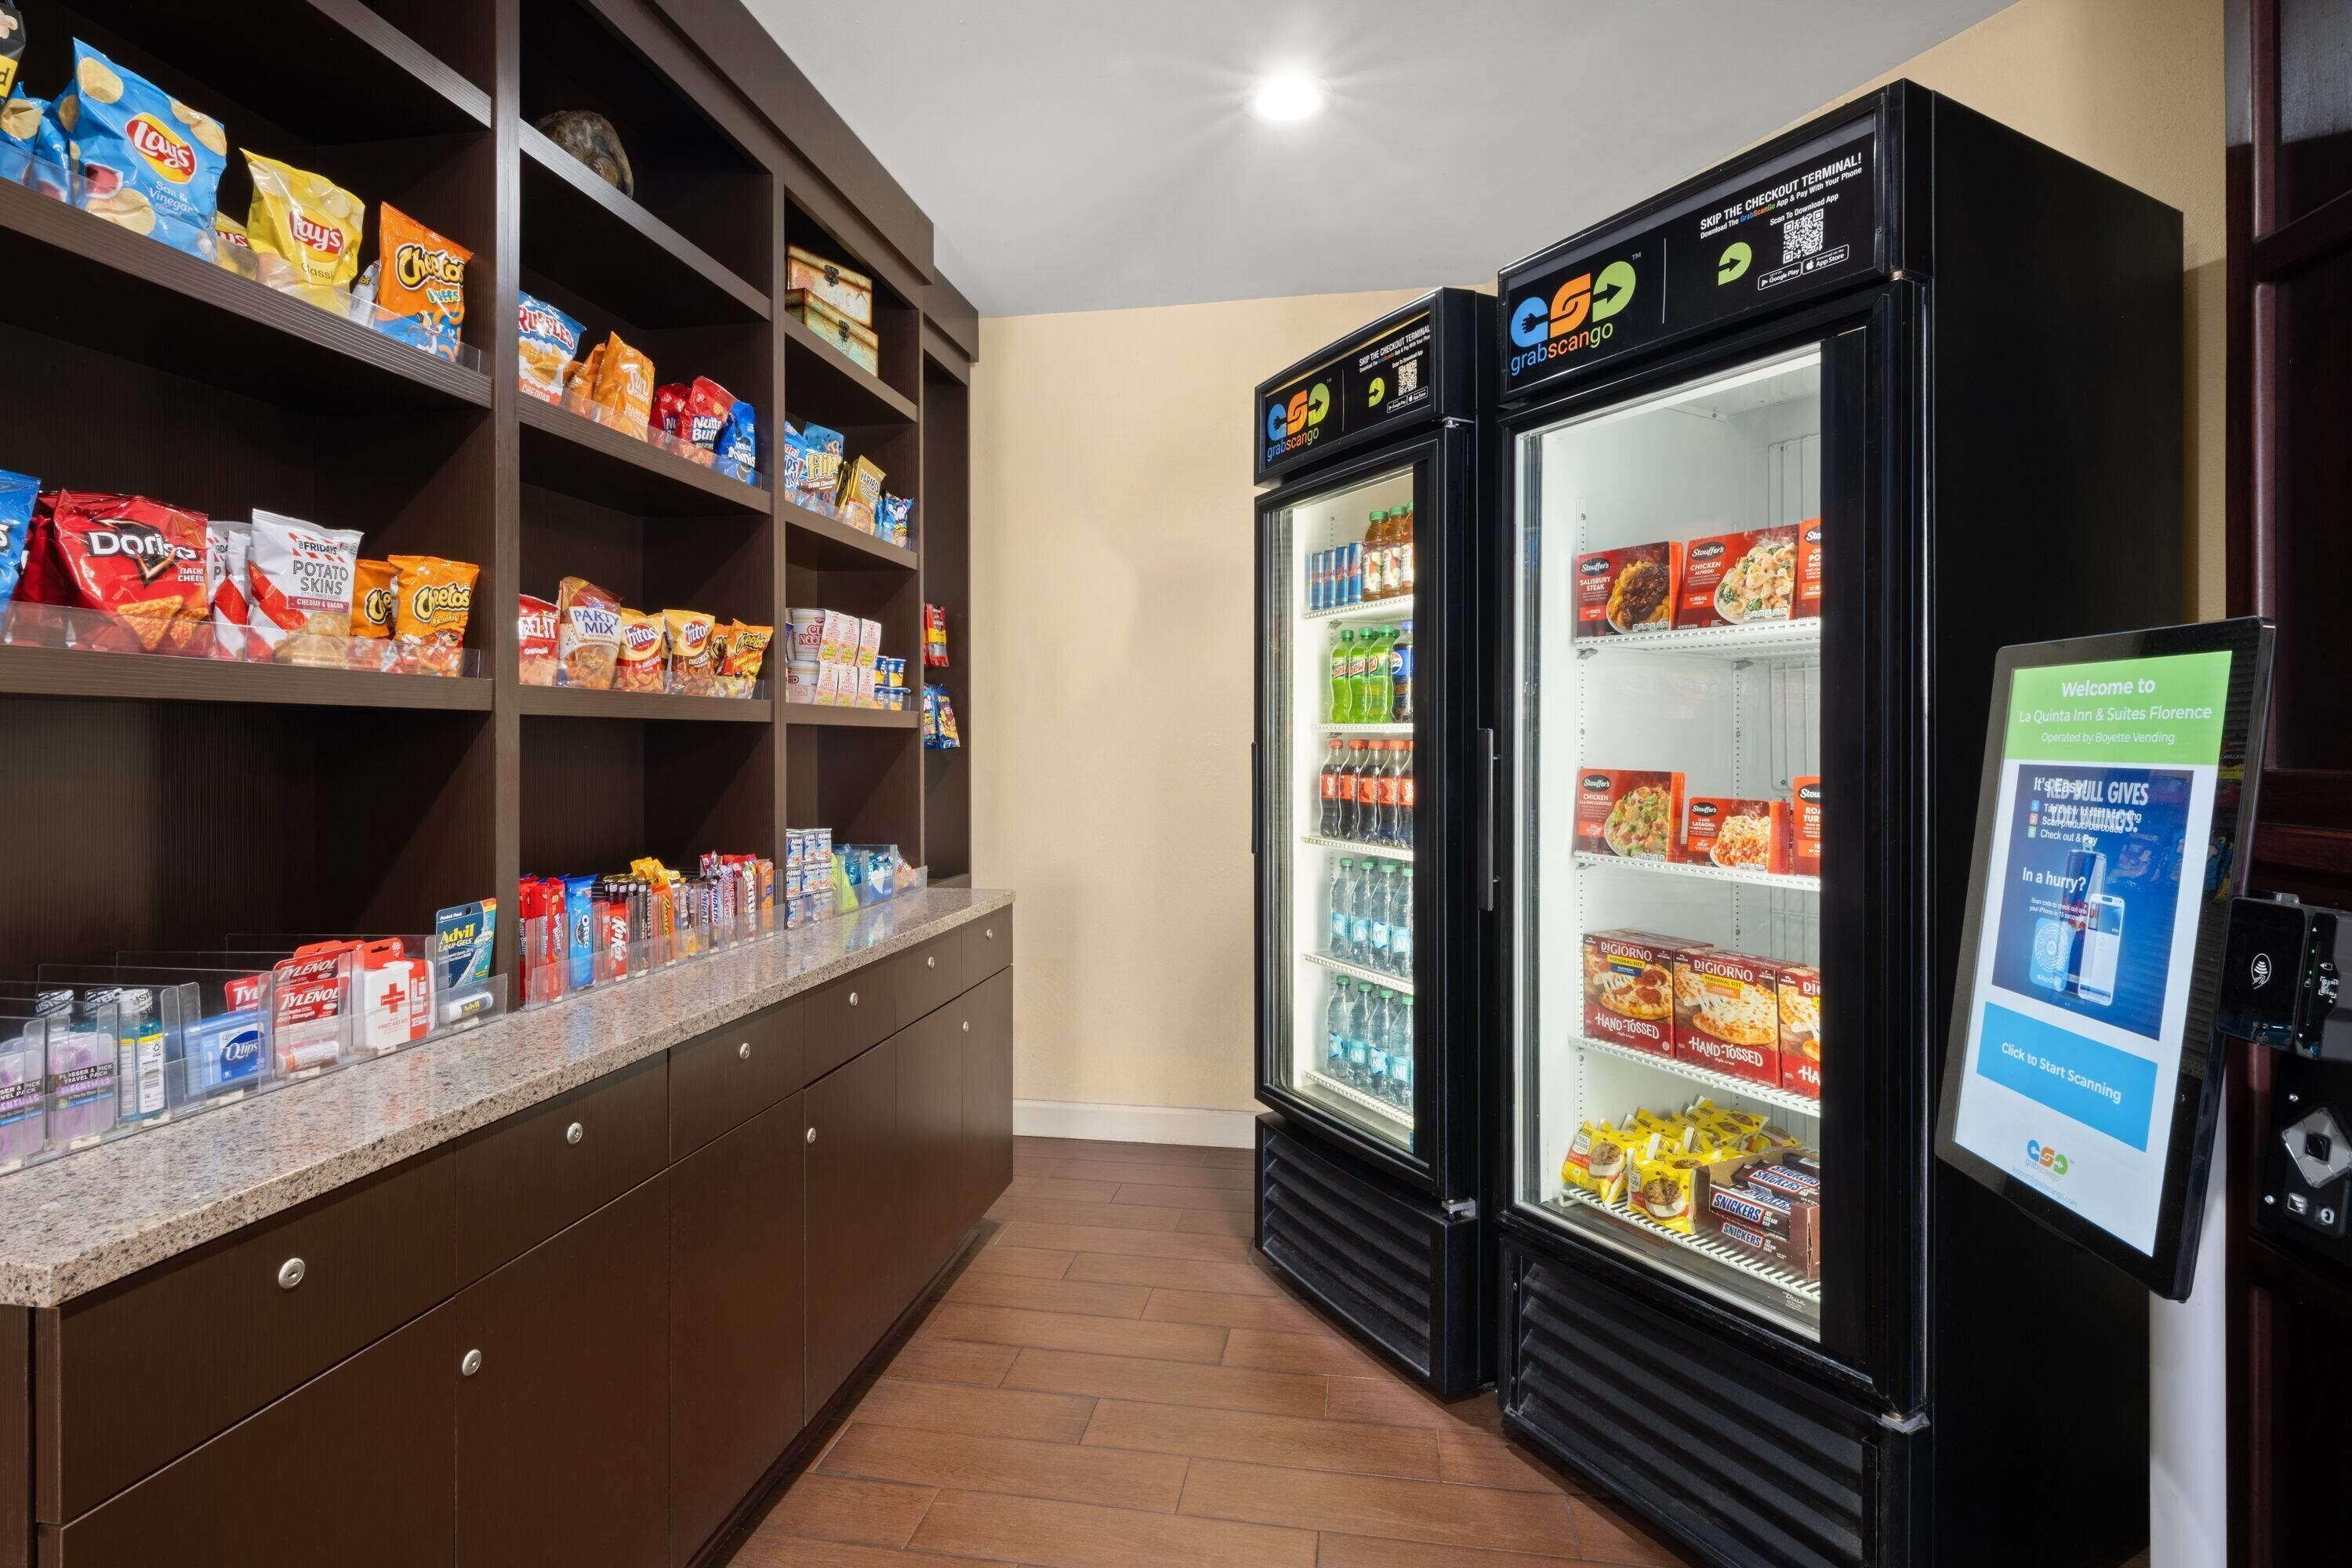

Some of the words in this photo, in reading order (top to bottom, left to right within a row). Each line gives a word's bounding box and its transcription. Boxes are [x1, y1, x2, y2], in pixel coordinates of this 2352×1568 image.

[133, 122, 191, 169] Lay's
[149, 187, 196, 213] Vinegar
[155, 181, 177, 198] Salt
[180, 191, 189, 202] &
[1700, 213, 1722, 230] SKIP
[1724, 203, 1742, 220] THE
[1745, 180, 1798, 211] CHECKOUT
[1802, 152, 1861, 187] TERMINAL!
[1700, 223, 1727, 239] Download
[1729, 218, 1739, 227] The
[1740, 203, 1775, 223] GrabScanGo
[1777, 198, 1788, 208] App
[1796, 191, 1808, 200] Pay
[1809, 183, 1824, 194] With
[1825, 176, 1839, 189] Your
[1842, 167, 1862, 180] Phone
[1770, 216, 1784, 226] Scan
[1795, 200, 1824, 215] Download
[1826, 194, 1838, 204] App
[290, 210, 343, 251] Lay's
[302, 263, 334, 279] Classi
[397, 244, 464, 290] Cheetos
[1769, 274, 1787, 283] Google
[519, 305, 574, 350] RUFFLES
[1359, 355, 1370, 366] SKIP
[1370, 350, 1379, 361] THE
[1381, 338, 1404, 356] CHECKOUT
[1511, 323, 1613, 376] grabscango
[521, 384, 550, 401] CHEDDAR
[693, 416, 722, 430] Nutte
[691, 429, 717, 441] Butt
[1267, 427, 1319, 462] grabscango
[807, 453, 842, 480] Flip
[860, 468, 880, 494] HARIBO
[88, 532, 198, 560] Doritos
[304, 542, 337, 555] FRIDAYS
[1692, 546, 1724, 557] Stouffer's
[293, 560, 349, 582] POTATO
[1581, 562, 1609, 572] Stouffer's
[1690, 561, 1721, 571] CHICKEN
[301, 577, 343, 595] SKINS
[1581, 576, 1610, 586] SALISBURY
[297, 598, 321, 607] CHEDDAR
[413, 582, 470, 623] Cheetos
[574, 610, 619, 626] PARTY
[584, 622, 614, 635] MIX
[623, 625, 659, 649] Fritos
[2062, 681, 2132, 698] Welcome
[2138, 678, 2155, 693] to
[2020, 710, 2031, 722] La
[2034, 710, 2070, 724] Quinta
[2074, 709, 2092, 721] Inn
[2096, 710, 2103, 720] &
[2107, 707, 2146, 721] Suites
[2150, 706, 2212, 720] Florence
[2042, 732, 2080, 743] Operated
[2083, 732, 2093, 744] by
[2095, 732, 2130, 745] Boyette
[2132, 732, 2175, 745] Vending
[1584, 779, 1610, 788] Stouffer's
[2034, 777, 2049, 791] It's
[2108, 782, 2149, 805] GIVES
[2042, 816, 2060, 826] Scan
[2041, 829, 2061, 840] Check
[2063, 833, 2074, 841] out
[2083, 834, 2098, 847] Pay
[2022, 867, 2034, 883] In
[2035, 873, 2043, 884] a
[2046, 871, 2086, 893] hurry?
[440, 924, 474, 945] Advil
[278, 959, 336, 982] TYLENOL
[1610, 956, 1632, 965] PERSONAL
[1705, 976, 1730, 985] PERSONAL
[281, 988, 338, 1010] TYLENOL
[464, 1000, 480, 1012] Advil
[292, 1011, 315, 1019] Strength
[1595, 1013, 1659, 1040] HAND-TOSSED
[1689, 1036, 1763, 1067] HAND-TOSSED
[64, 1075, 87, 1083] TRAVEL
[2002, 1043, 2025, 1062] Click
[2027, 1054, 2037, 1066] to
[2039, 1058, 2065, 1079] Start
[2068, 1070, 2122, 1104] Scanning
[2026, 1159, 2060, 1181] grabscango
[1753, 1171, 1804, 1192] SNICKERS
[1714, 1195, 1763, 1222] SNICKERS
[1763, 1215, 1777, 1225] CREAM
[1723, 1224, 1761, 1247] SNICKERS
